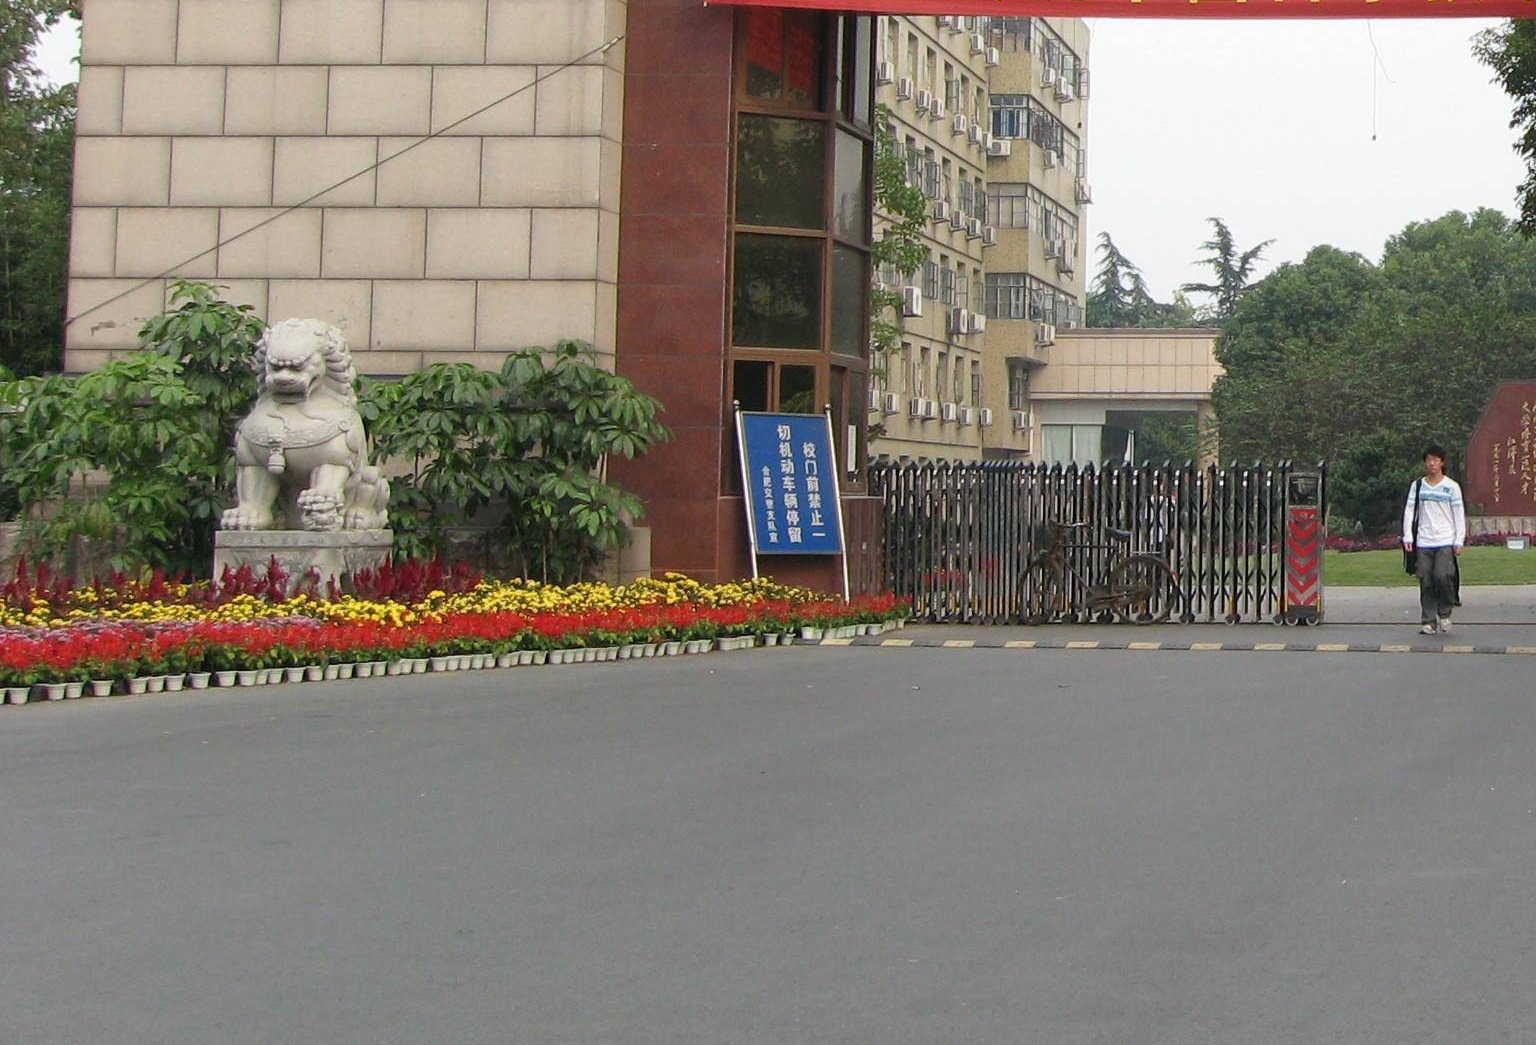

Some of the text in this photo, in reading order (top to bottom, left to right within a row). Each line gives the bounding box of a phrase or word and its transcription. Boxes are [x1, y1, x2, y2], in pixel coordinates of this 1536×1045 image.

[777, 424, 802, 544] 切机动车辆停留
